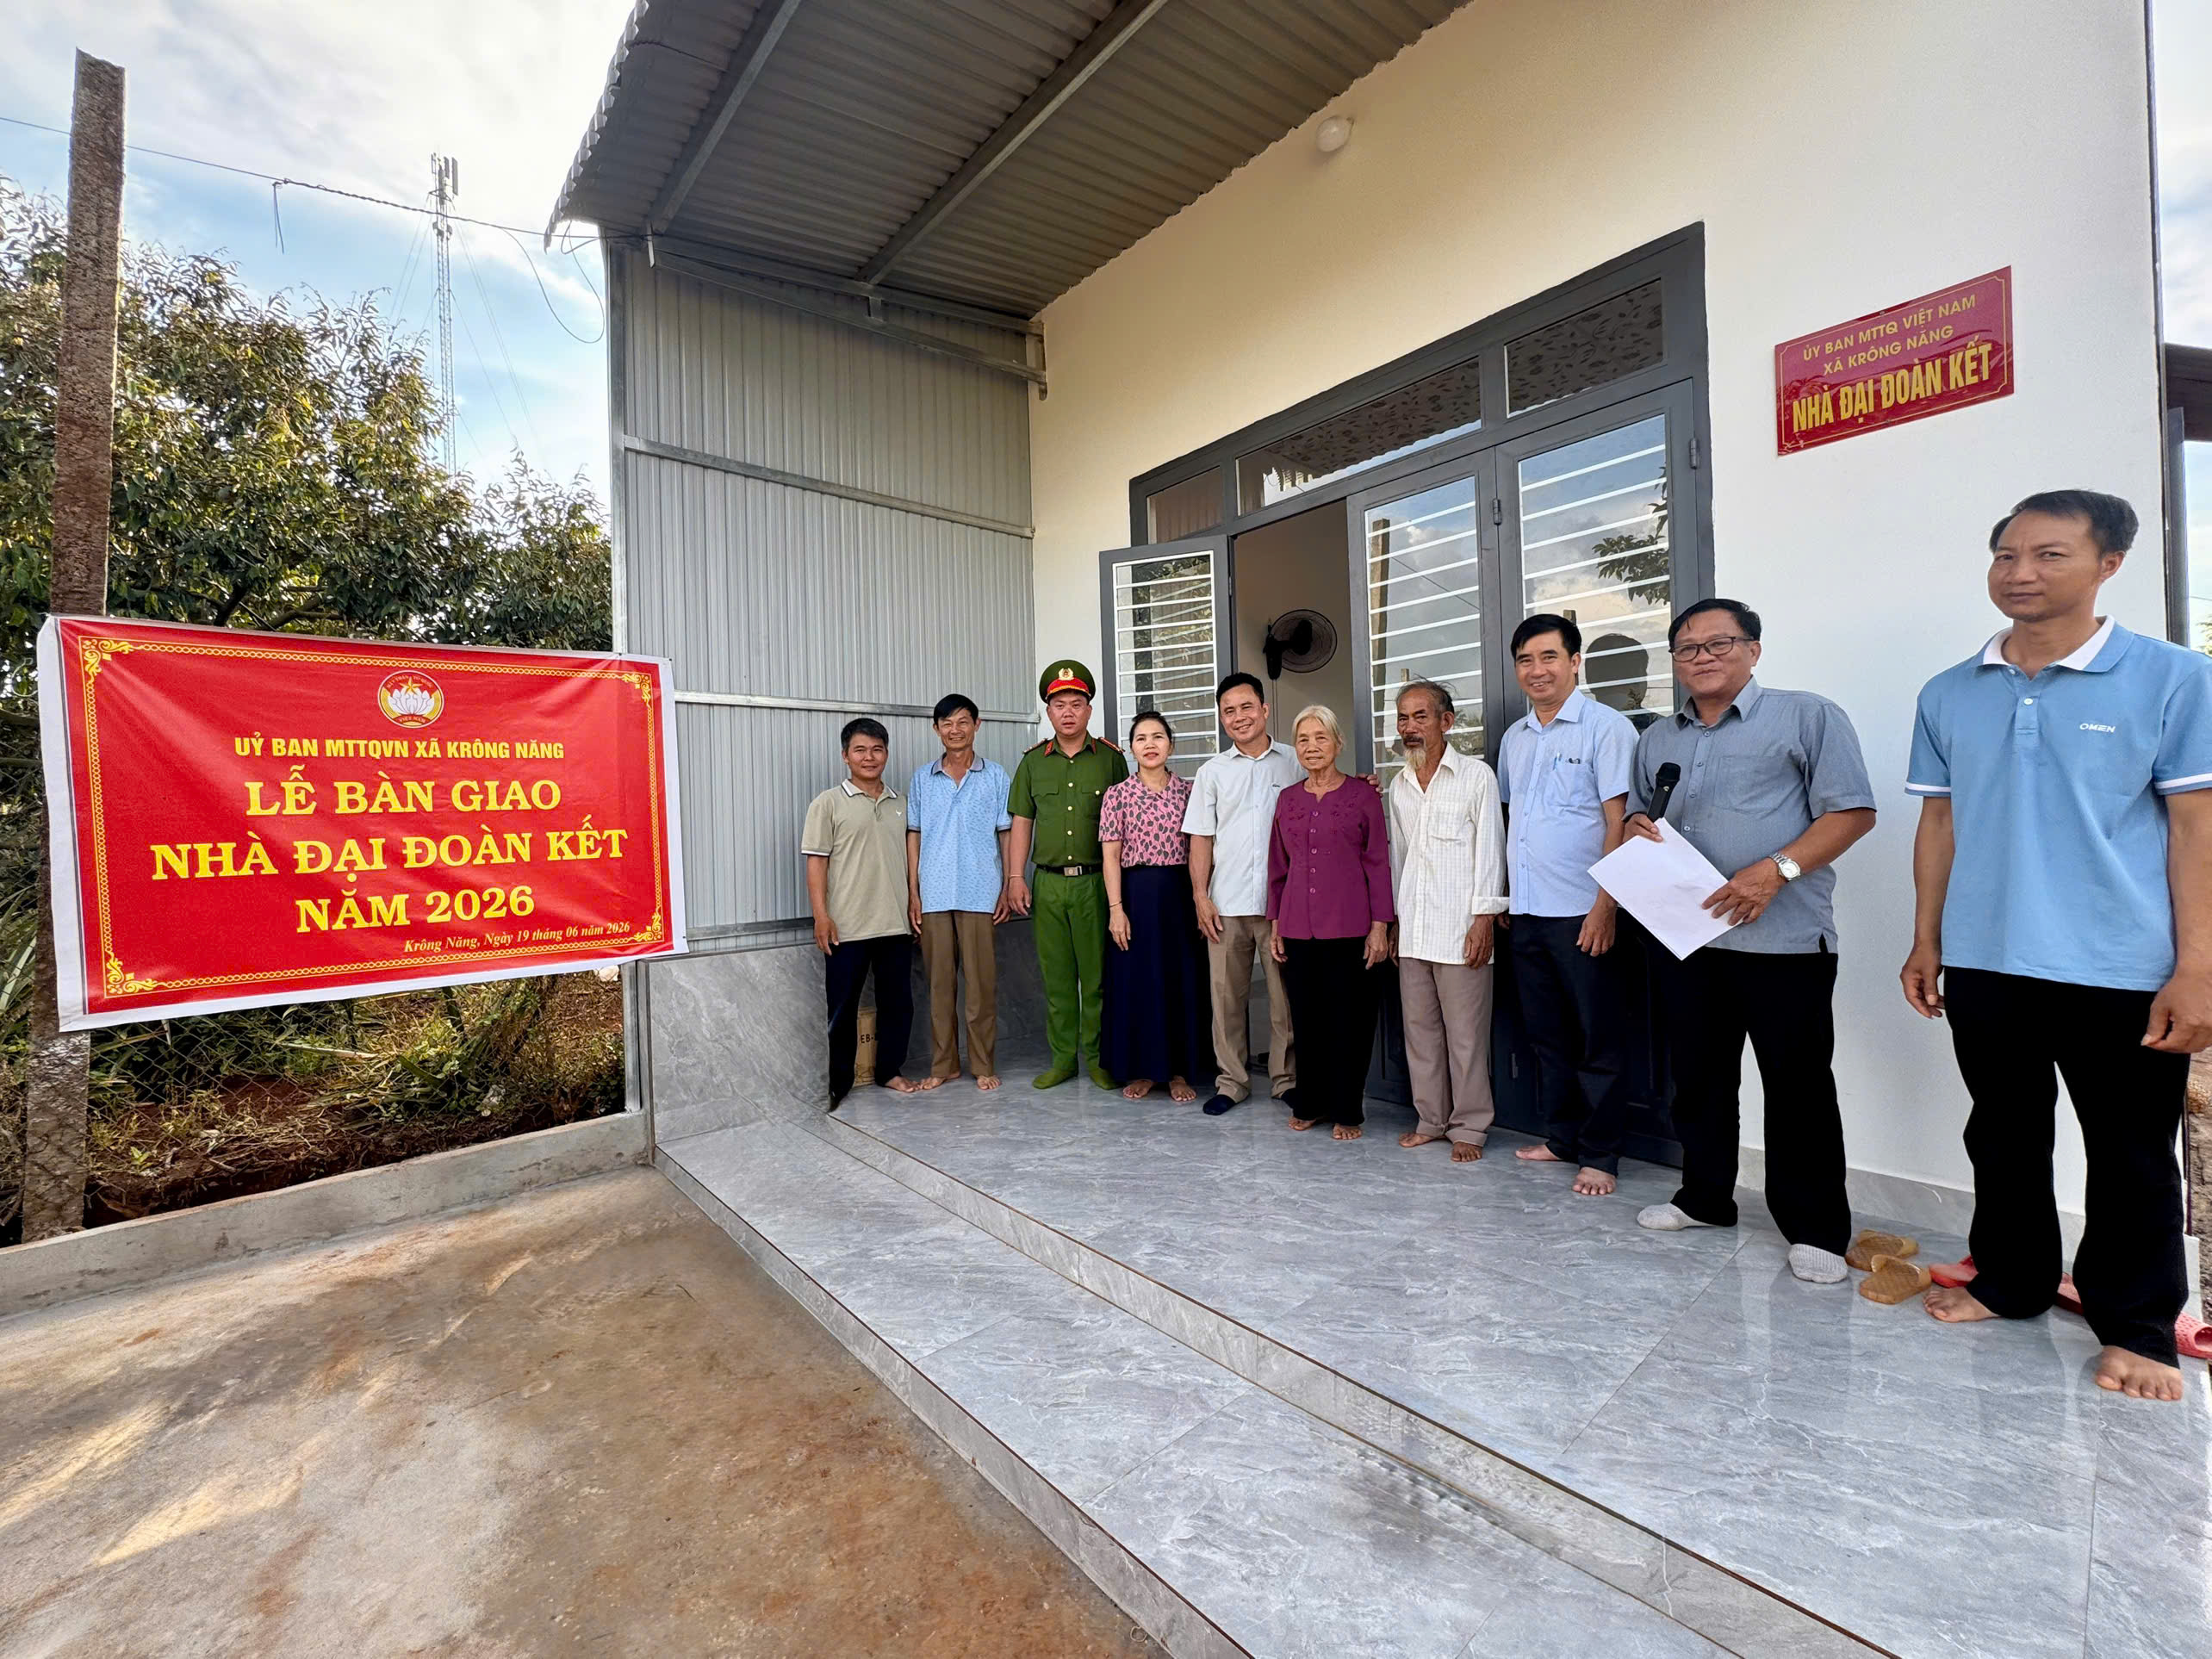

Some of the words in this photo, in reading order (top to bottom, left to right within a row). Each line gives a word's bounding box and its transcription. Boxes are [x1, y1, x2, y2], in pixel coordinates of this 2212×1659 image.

[1804, 345, 1820, 361] ỦY
[1825, 335, 1854, 355] BAN
[1859, 321, 1898, 344] MTTQ
[1903, 308, 1933, 330] VIỆT
[1939, 295, 1976, 317] NAM
[1824, 357, 1843, 376] XÃ
[1849, 341, 1902, 368] KRÔNG
[1906, 325, 1954, 351] NĂNG
[1793, 385, 1834, 432] NHÀ
[1839, 379, 1874, 423] ĐẠI
[1880, 358, 1942, 409] ĐOÀN
[1949, 335, 1991, 390] KẾT
[234, 732, 264, 756] UỶ
[271, 738, 319, 757] BAN
[325, 739, 409, 760] MTTQVN
[414, 738, 442, 759] XÃ
[447, 738, 510, 759] KRÔNG
[515, 738, 564, 759] NĂNG
[2079, 723, 2116, 733] OMEN
[244, 764, 317, 816] LỄ
[333, 770, 435, 814] BÀN
[450, 780, 562, 812] GIAO
[150, 831, 278, 880] NHÀ
[293, 838, 388, 883] ĐẠI
[402, 824, 531, 867] ĐOÀN
[546, 814, 628, 861] KẾT
[295, 888, 410, 933] NĂM
[426, 885, 535, 923] 2026
[404, 938, 442, 953] Krông
[445, 936, 481, 949] Năng,
[484, 931, 513, 947] Ngày
[517, 929, 530, 942] 19
[531, 928, 563, 941] tháng
[565, 926, 579, 938] 06
[581, 924, 604, 937] năm
[606, 921, 631, 935] 2026
